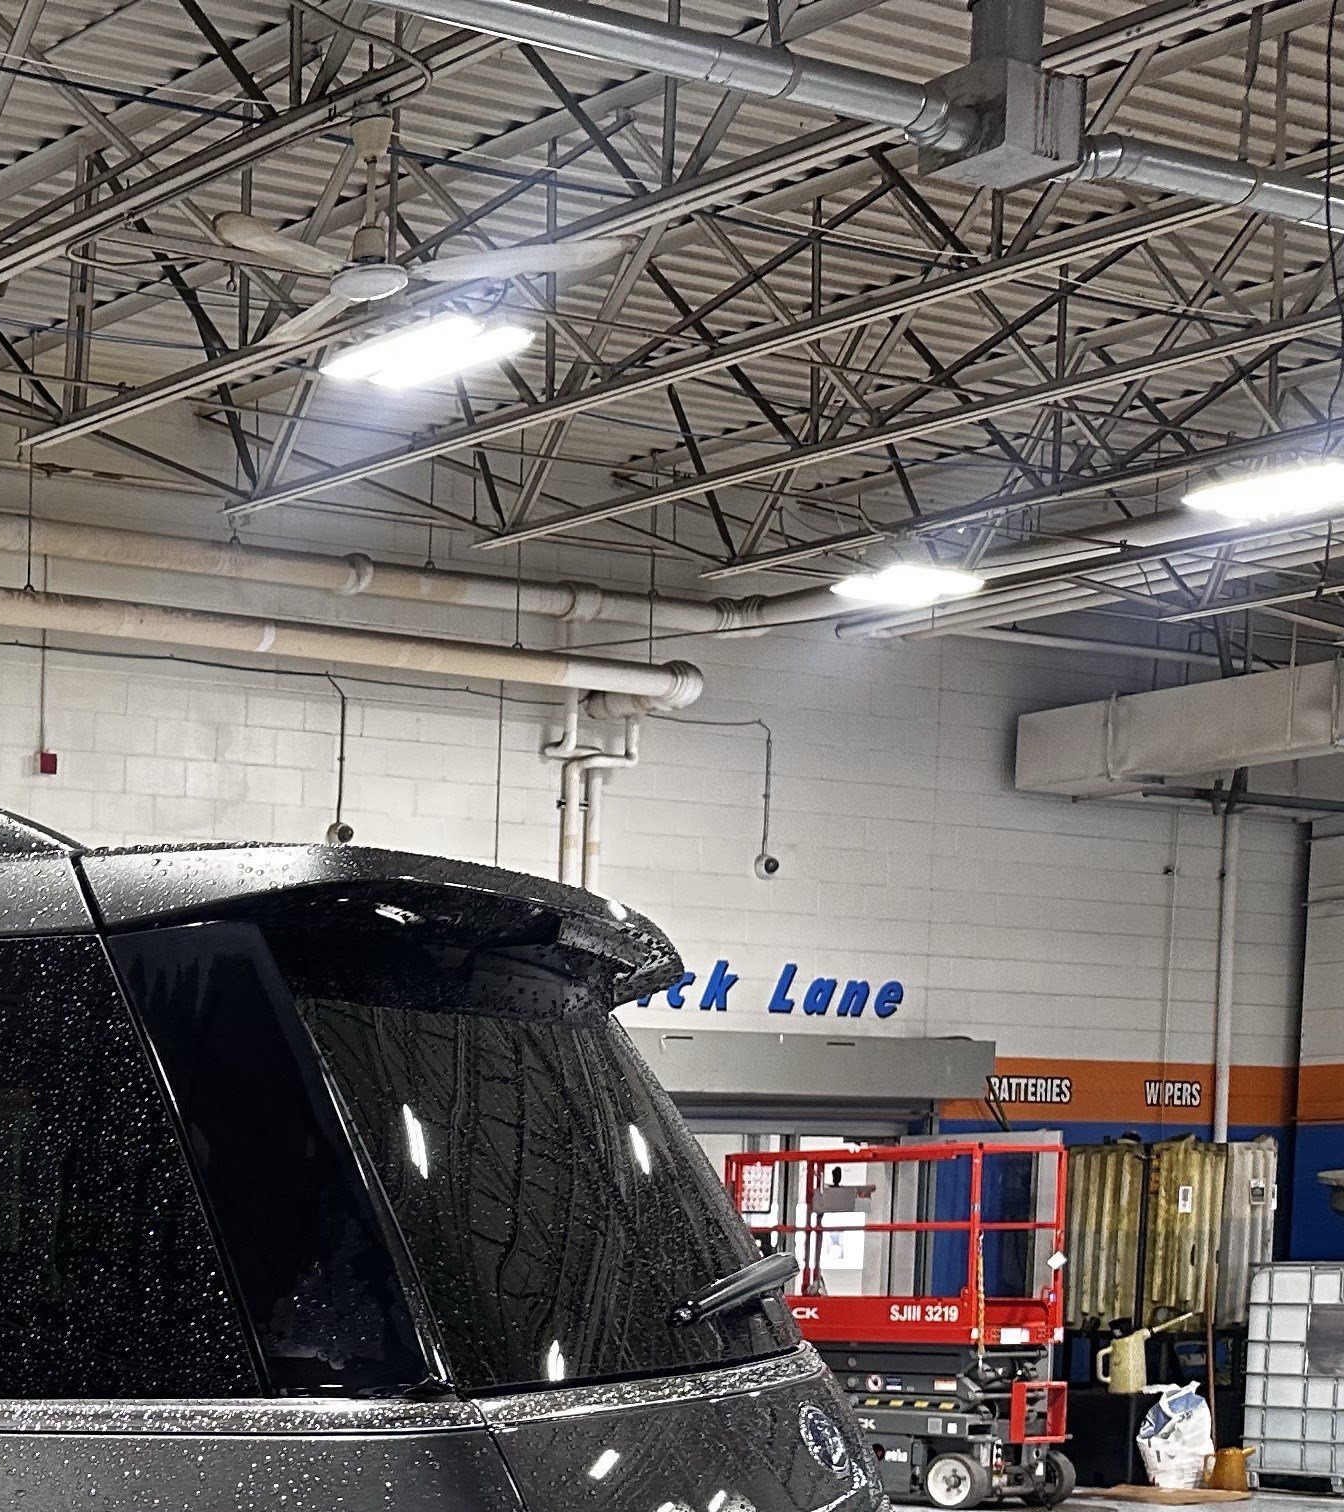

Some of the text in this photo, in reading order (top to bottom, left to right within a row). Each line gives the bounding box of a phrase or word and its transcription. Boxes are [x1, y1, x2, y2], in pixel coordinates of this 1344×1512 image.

[768, 963, 904, 1018] Lane
[988, 1076, 1072, 1103] BATTERIES
[924, 1305, 959, 1323] 3219
